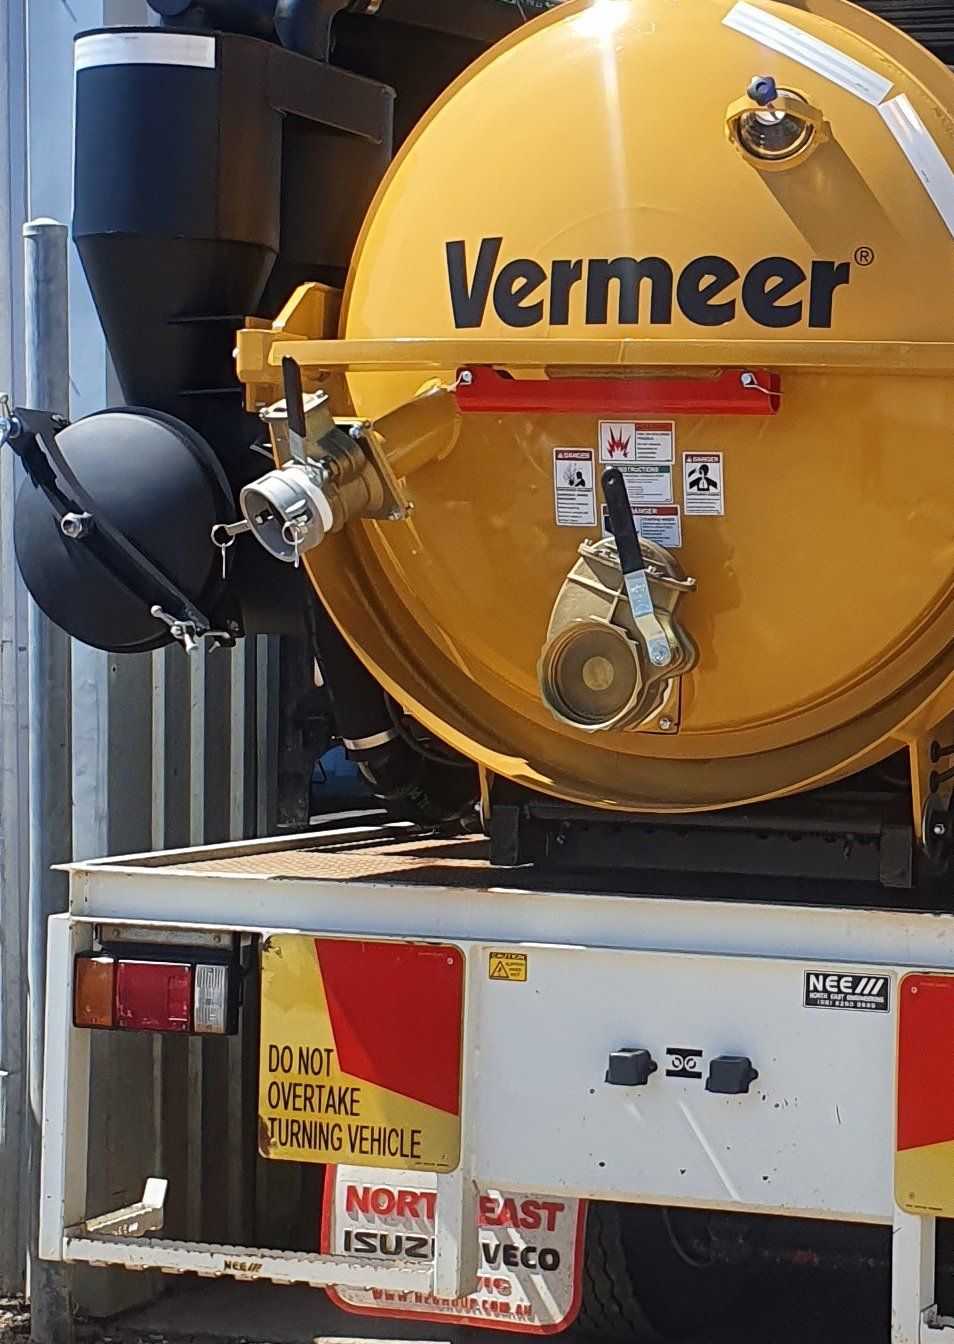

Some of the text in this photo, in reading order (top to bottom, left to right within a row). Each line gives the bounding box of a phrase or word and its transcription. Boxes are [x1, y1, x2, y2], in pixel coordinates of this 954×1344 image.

[446, 236, 850, 329] Vermeer
[268, 1044, 334, 1077] DO NOT
[268, 1081, 361, 1117] OVERTAKE
[268, 1117, 422, 1159] TURNING VEHICLE
[346, 1185, 565, 1232] NORT EAST
[343, 1230, 561, 1272] ISUZ VECO
